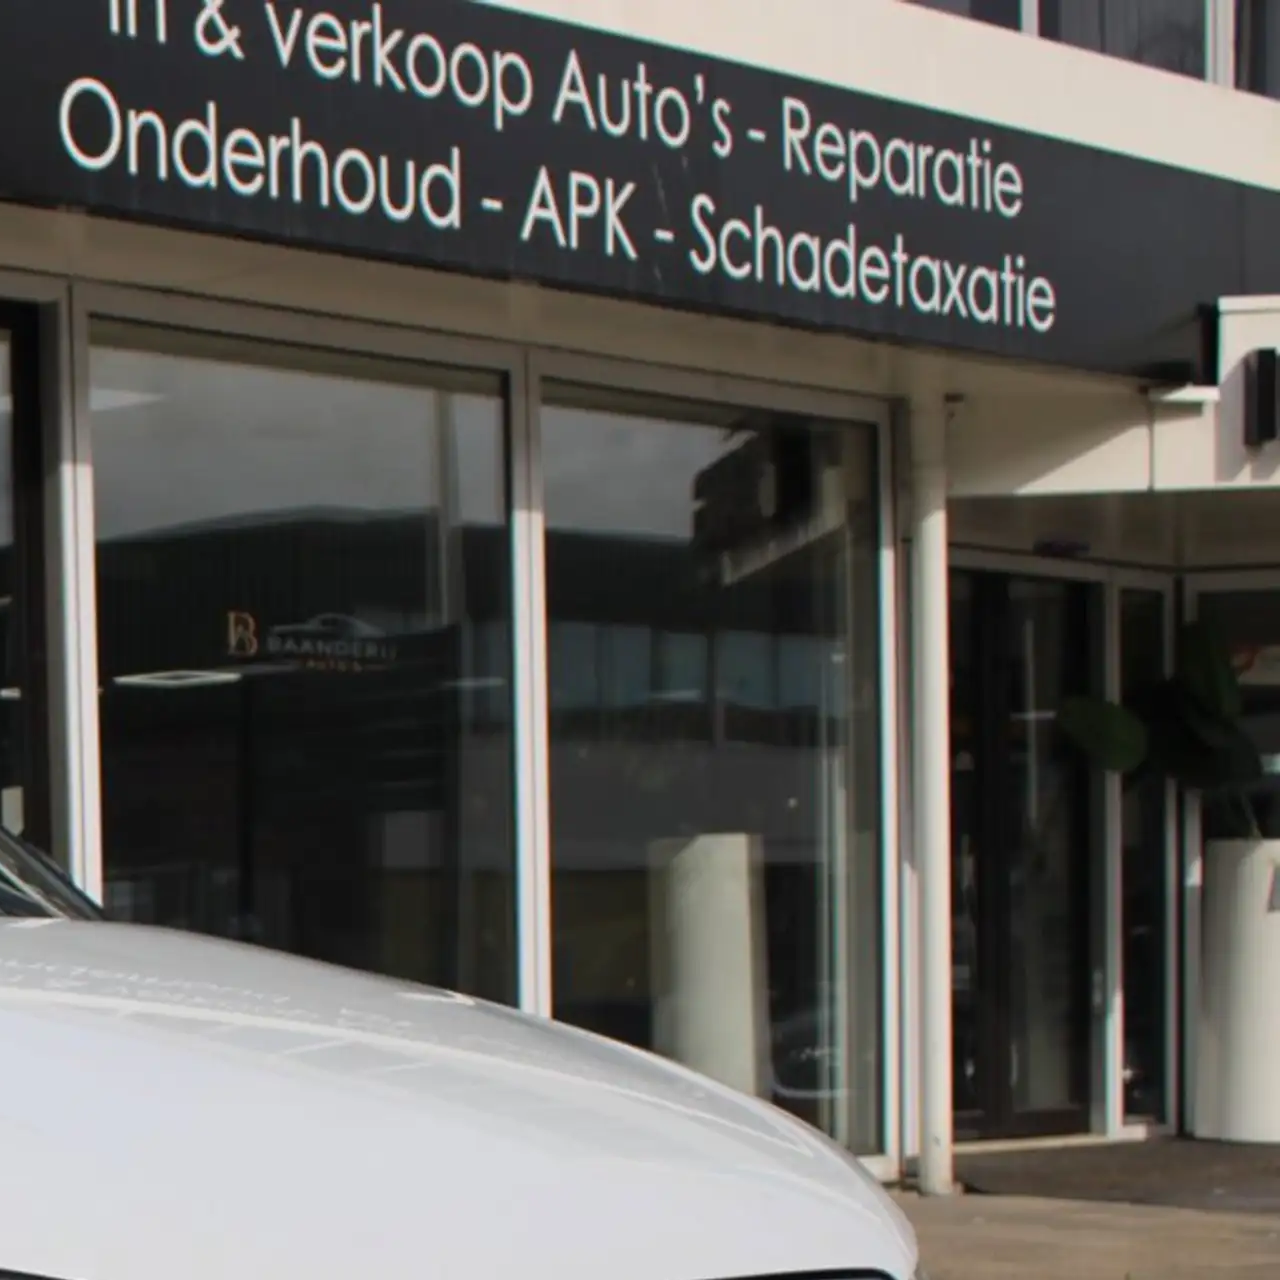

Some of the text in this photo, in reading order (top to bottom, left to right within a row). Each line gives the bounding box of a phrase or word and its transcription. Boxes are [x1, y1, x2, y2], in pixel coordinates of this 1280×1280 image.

[58, 77, 1056, 333] Onderhoud - APK - Schadetaxatie
[265, 2, 534, 132] verkoop
[551, 48, 733, 158] Auto's
[746, 128, 767, 143] -
[781, 95, 1024, 218] Reparatie
